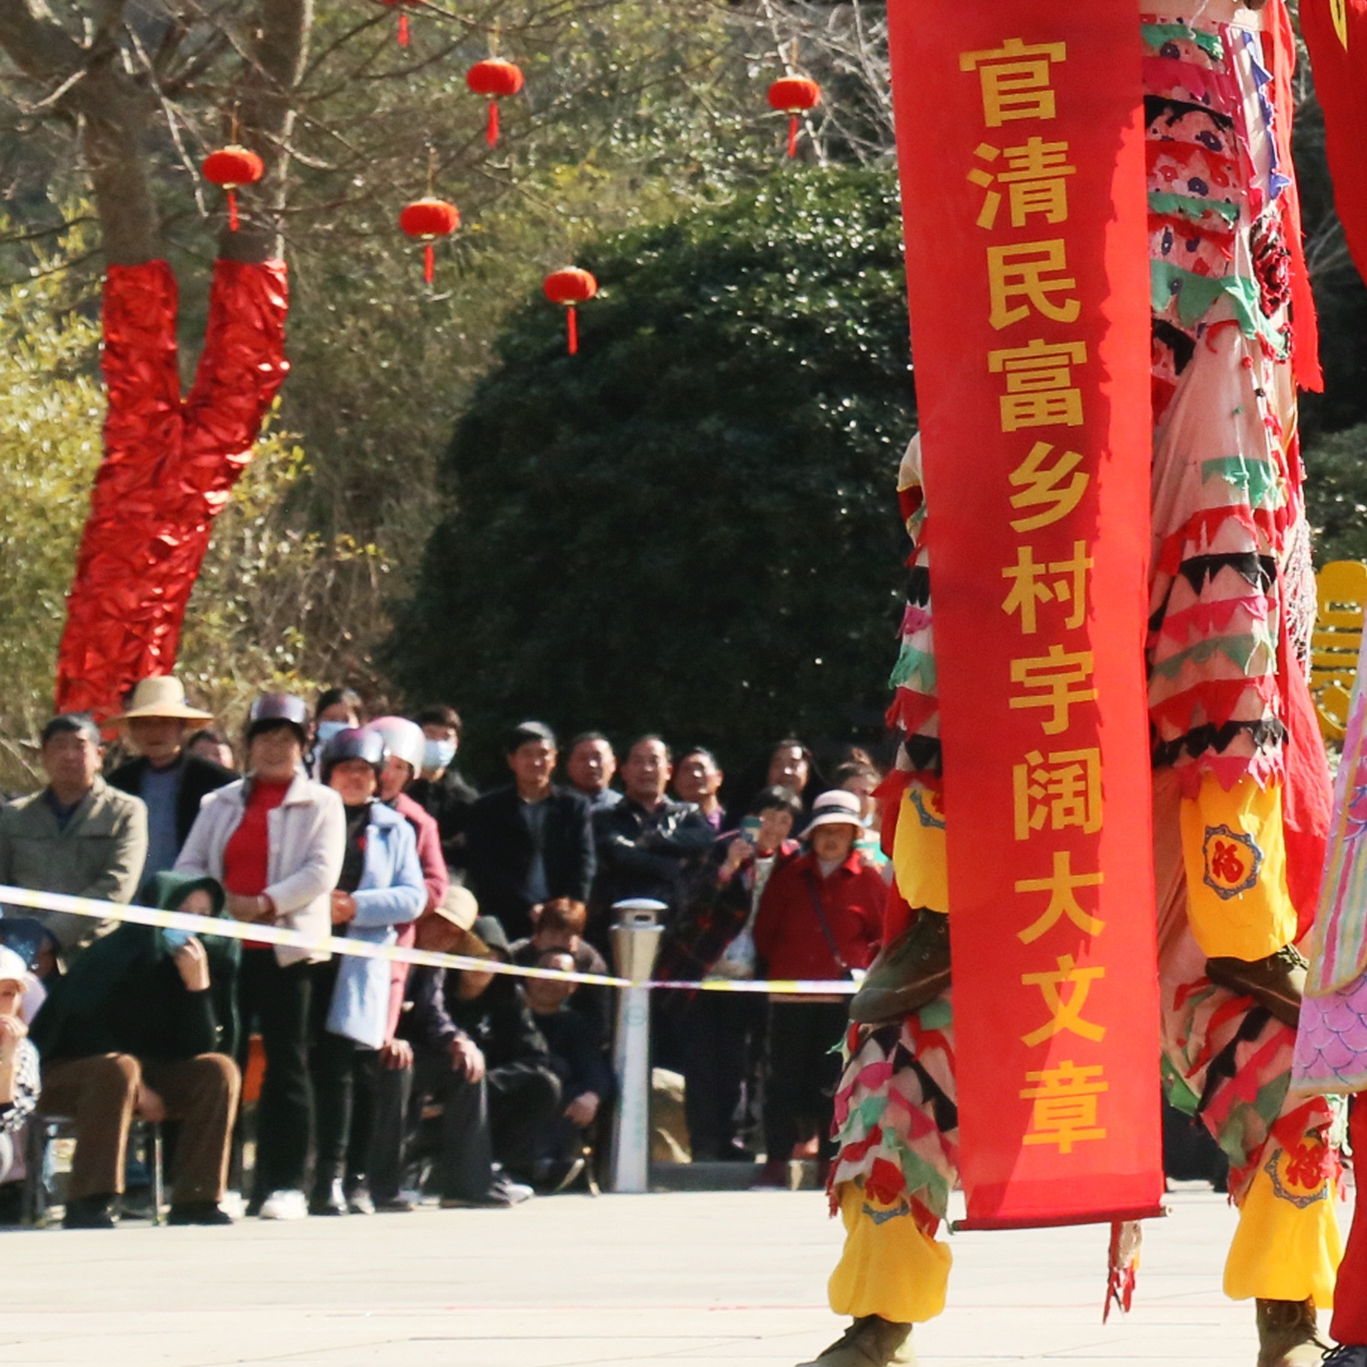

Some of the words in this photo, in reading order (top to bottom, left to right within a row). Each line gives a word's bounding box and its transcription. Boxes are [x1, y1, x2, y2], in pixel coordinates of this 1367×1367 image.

[960, 39, 1109, 1154] 官清民富乡村宇阔大文章
